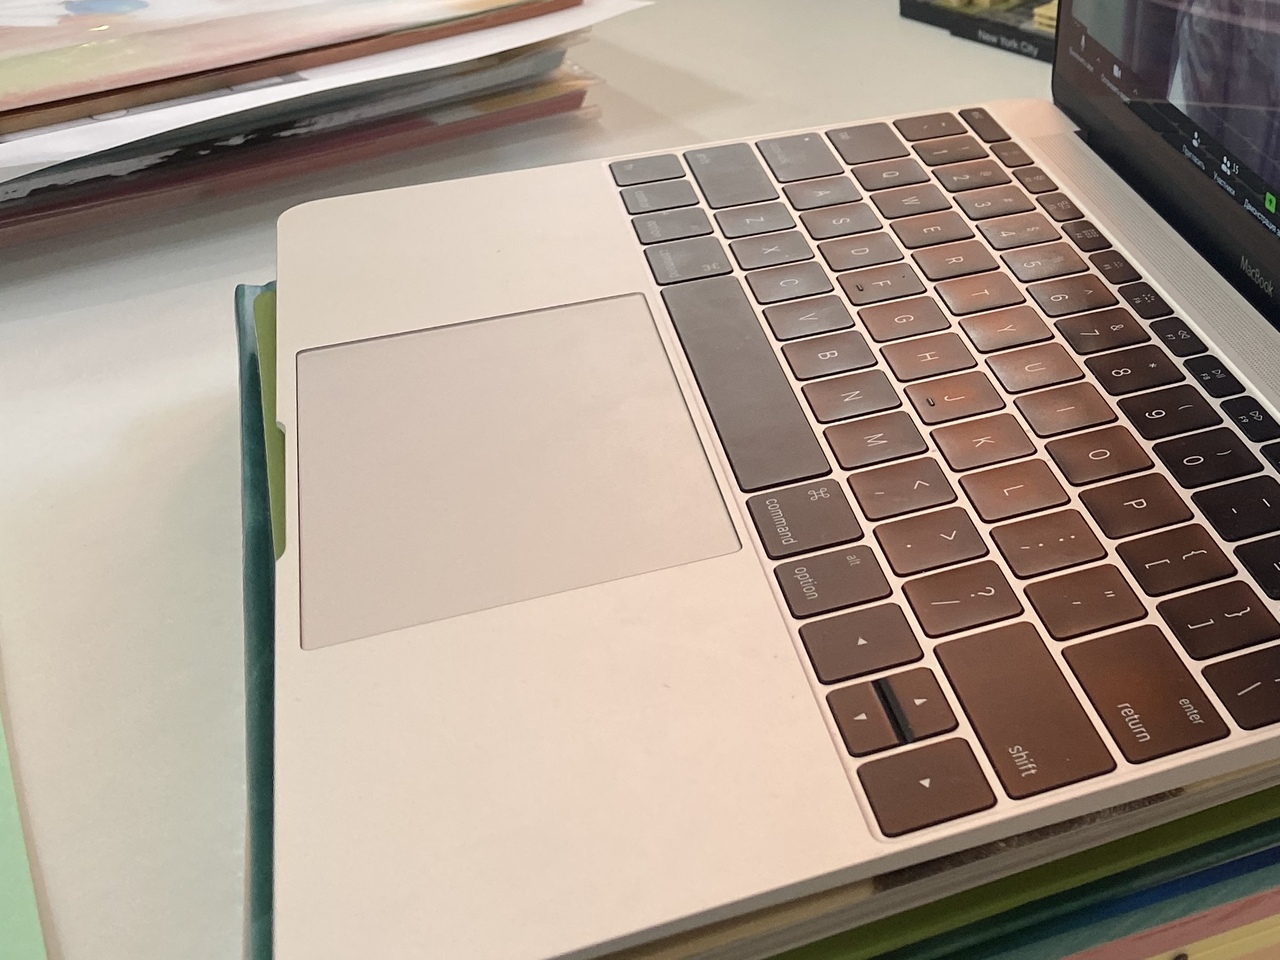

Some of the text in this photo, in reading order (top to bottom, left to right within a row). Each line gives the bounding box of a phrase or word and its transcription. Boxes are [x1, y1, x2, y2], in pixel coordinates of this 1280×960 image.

[1232, 162, 1239, 175] 15
[953, 173, 970, 182] 2
[813, 189, 831, 199] A
[901, 195, 921, 206] W
[974, 200, 992, 209] 3
[745, 215, 765, 224] Z
[832, 216, 850, 225] S
[923, 225, 942, 234] E
[1000, 230, 1016, 238] 4
[762, 245, 781, 255] X
[850, 246, 870, 256] D
[945, 255, 964, 265] R
[1023, 260, 1042, 269] 5
[1239, 255, 1274, 298] MacBook
[779, 278, 799, 288] C
[872, 279, 892, 288] F
[970, 288, 990, 297] T
[1050, 293, 1069, 303] 6
[798, 312, 819, 322] V
[894, 314, 914, 324] G
[996, 324, 1017, 334] Y
[1080, 328, 1100, 338] 7
[817, 350, 839, 360] B
[917, 351, 939, 363] H
[1024, 361, 1047, 373] U
[1111, 367, 1132, 378] 8
[841, 390, 863, 403] N
[943, 394, 966, 403] J
[1145, 409, 1166, 419] 9
[1238, 415, 1249, 424] F9
[863, 432, 888, 447] M
[972, 435, 996, 448] K
[1088, 449, 1111, 460] O
[1003, 484, 1024, 497] L
[1123, 498, 1147, 509] P
[765, 498, 798, 546] command
[846, 554, 863, 567] alt
[794, 566, 819, 601] option
[1178, 698, 1205, 725] enter
[1116, 702, 1151, 743] return
[1008, 744, 1038, 778] shift
